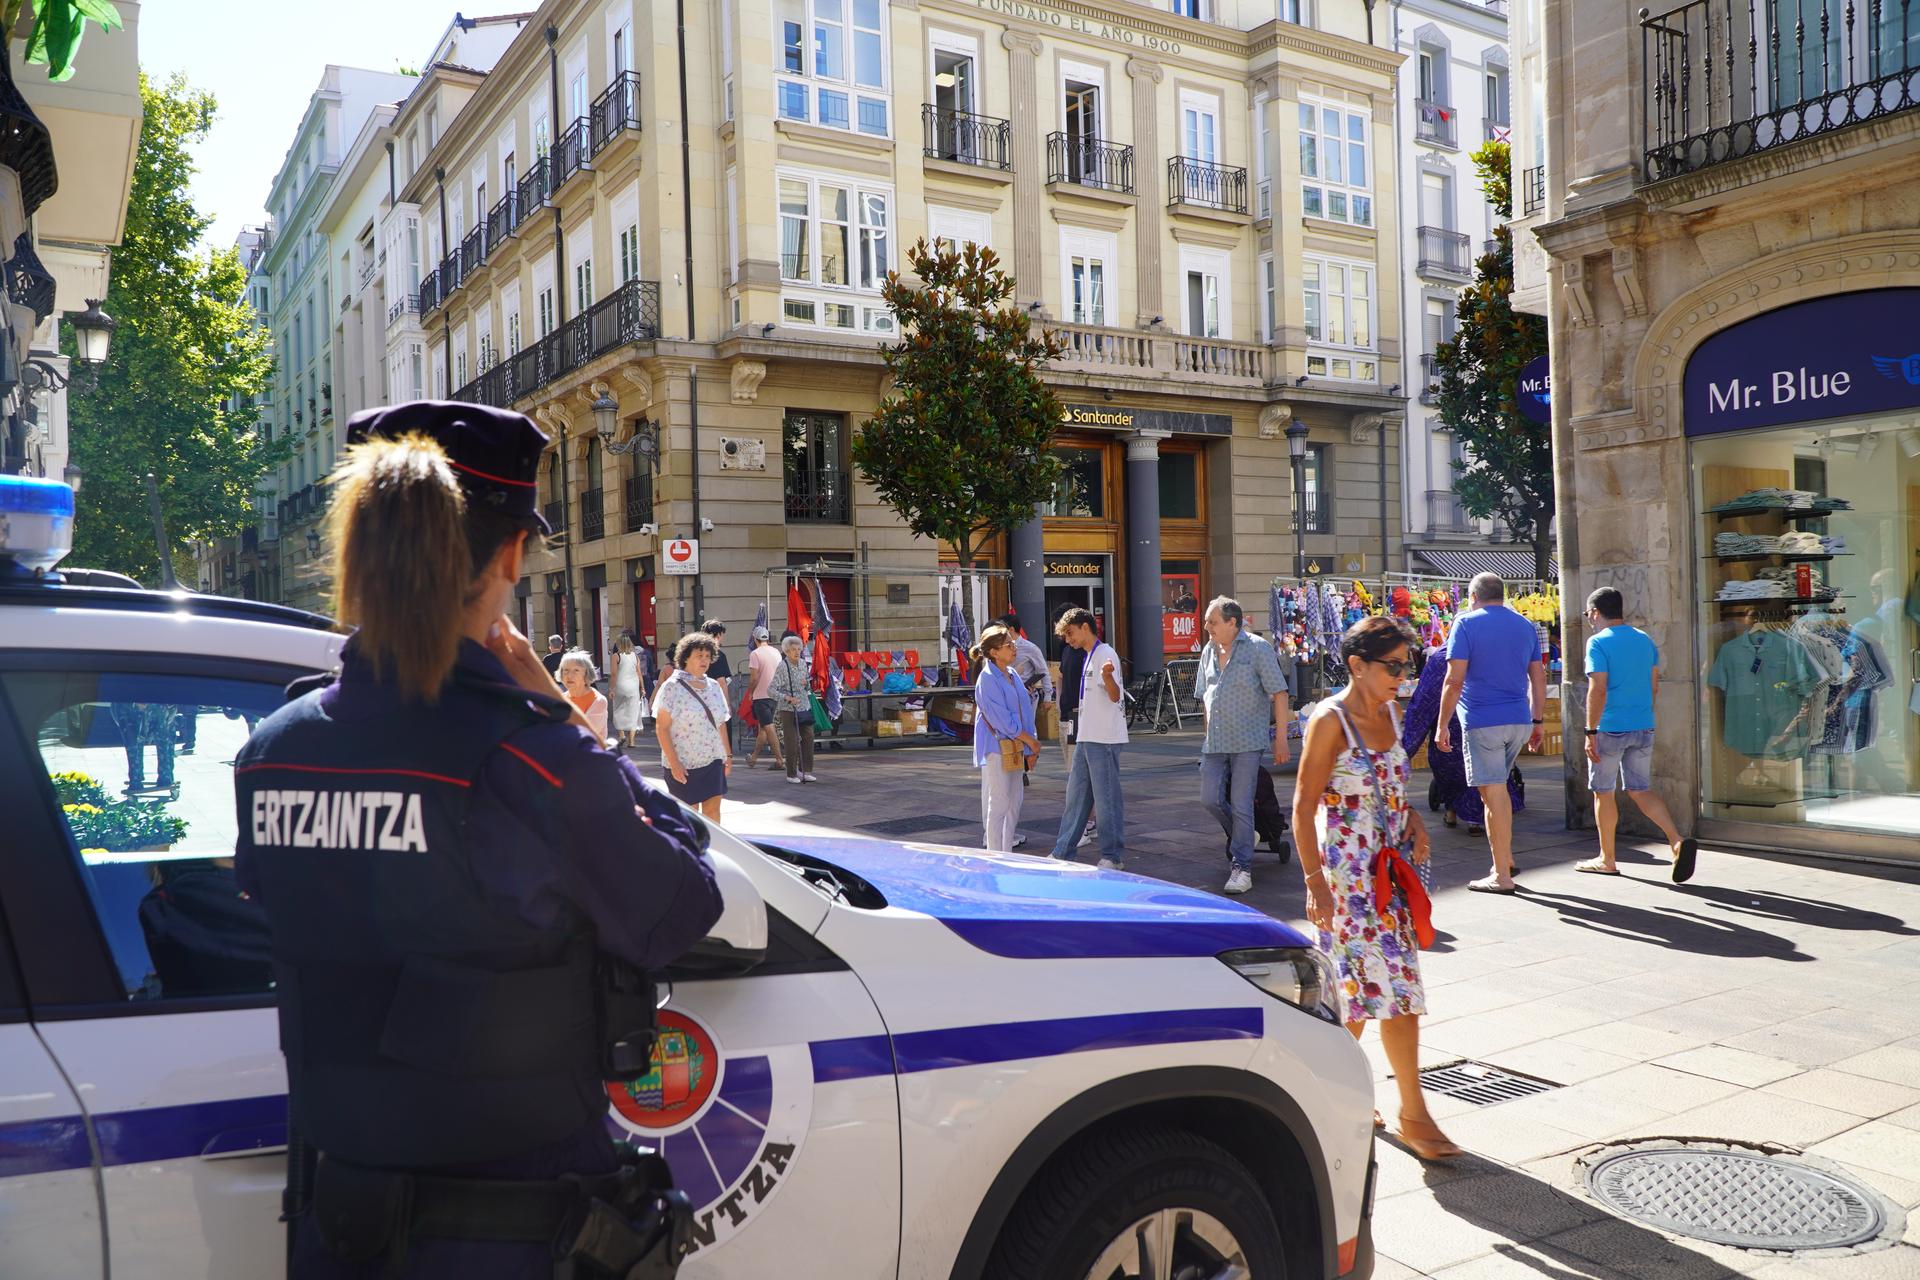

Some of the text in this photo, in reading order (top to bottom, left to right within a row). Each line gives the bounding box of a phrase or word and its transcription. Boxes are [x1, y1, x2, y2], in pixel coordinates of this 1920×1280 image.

[977, 0, 1061, 25] FUNDADO
[1070, 17, 1091, 33] EL
[1522, 379, 1542, 393] Mr.
[1709, 366, 1851, 414] Mr. Blue
[1073, 409, 1134, 426] Santander
[1050, 562, 1100, 574] Santander
[253, 790, 428, 853] ERTZAINTZA
[686, 1141, 796, 1255] NTZA
